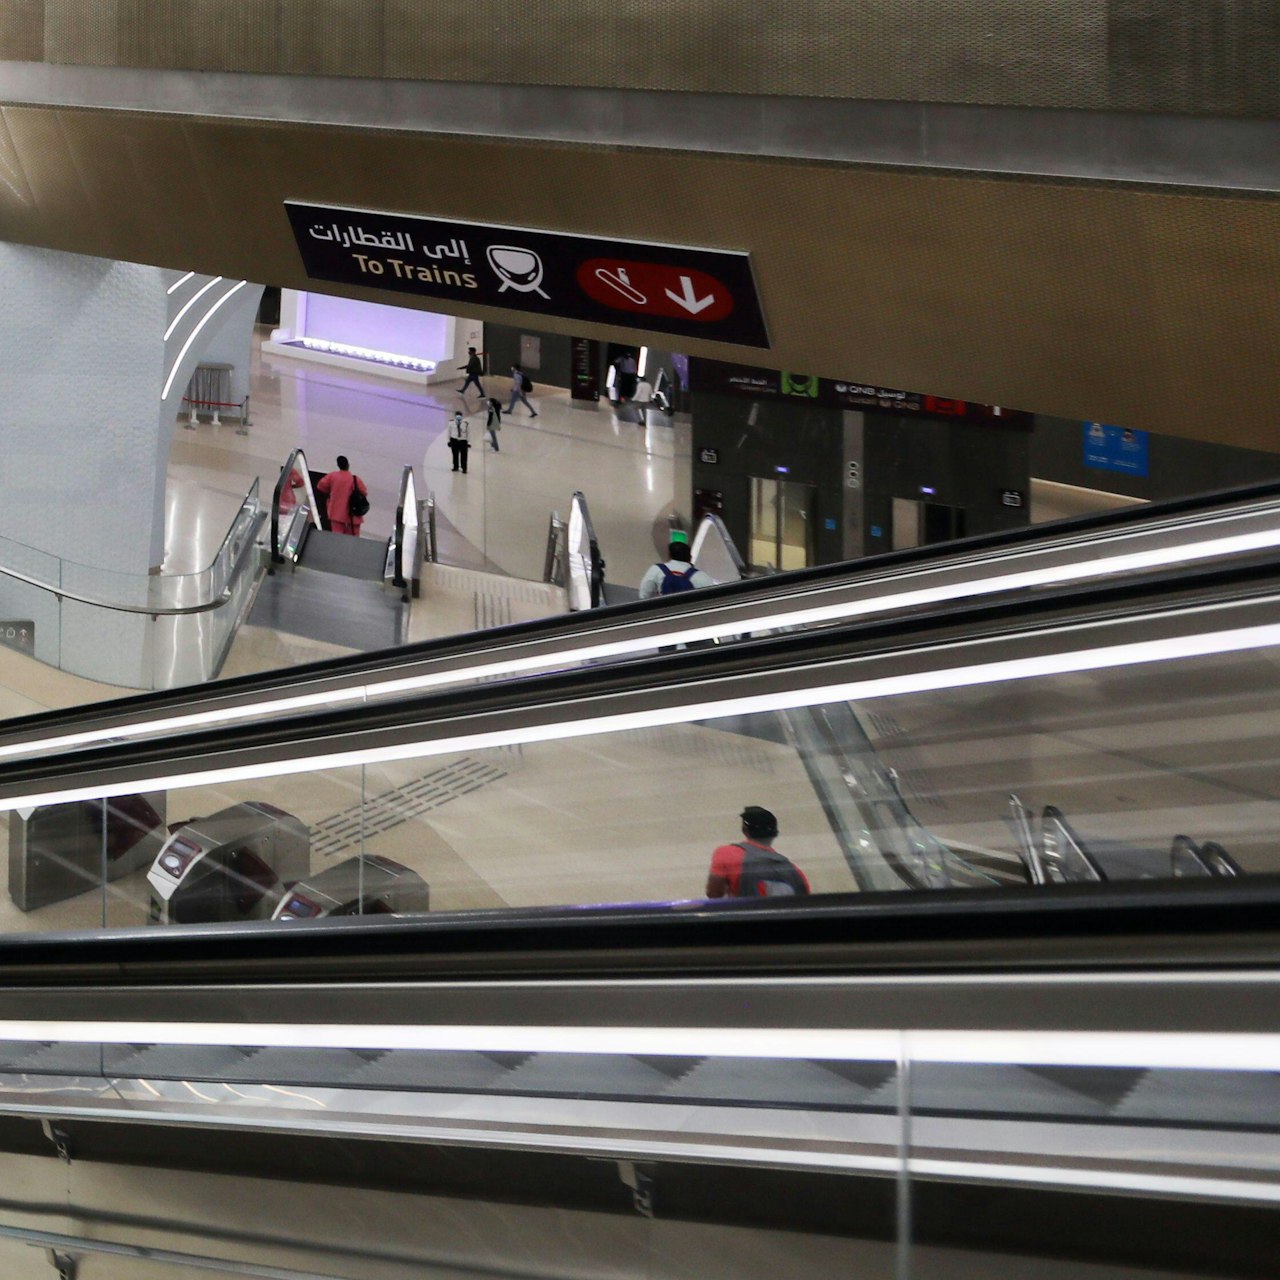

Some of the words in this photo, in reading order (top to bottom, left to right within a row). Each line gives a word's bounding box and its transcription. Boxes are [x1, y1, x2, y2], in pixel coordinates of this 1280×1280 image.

[308, 223, 415, 252] القطارات
[422, 238, 472, 266] إلى
[351, 253, 385, 275] To
[386, 258, 479, 289] Trains
